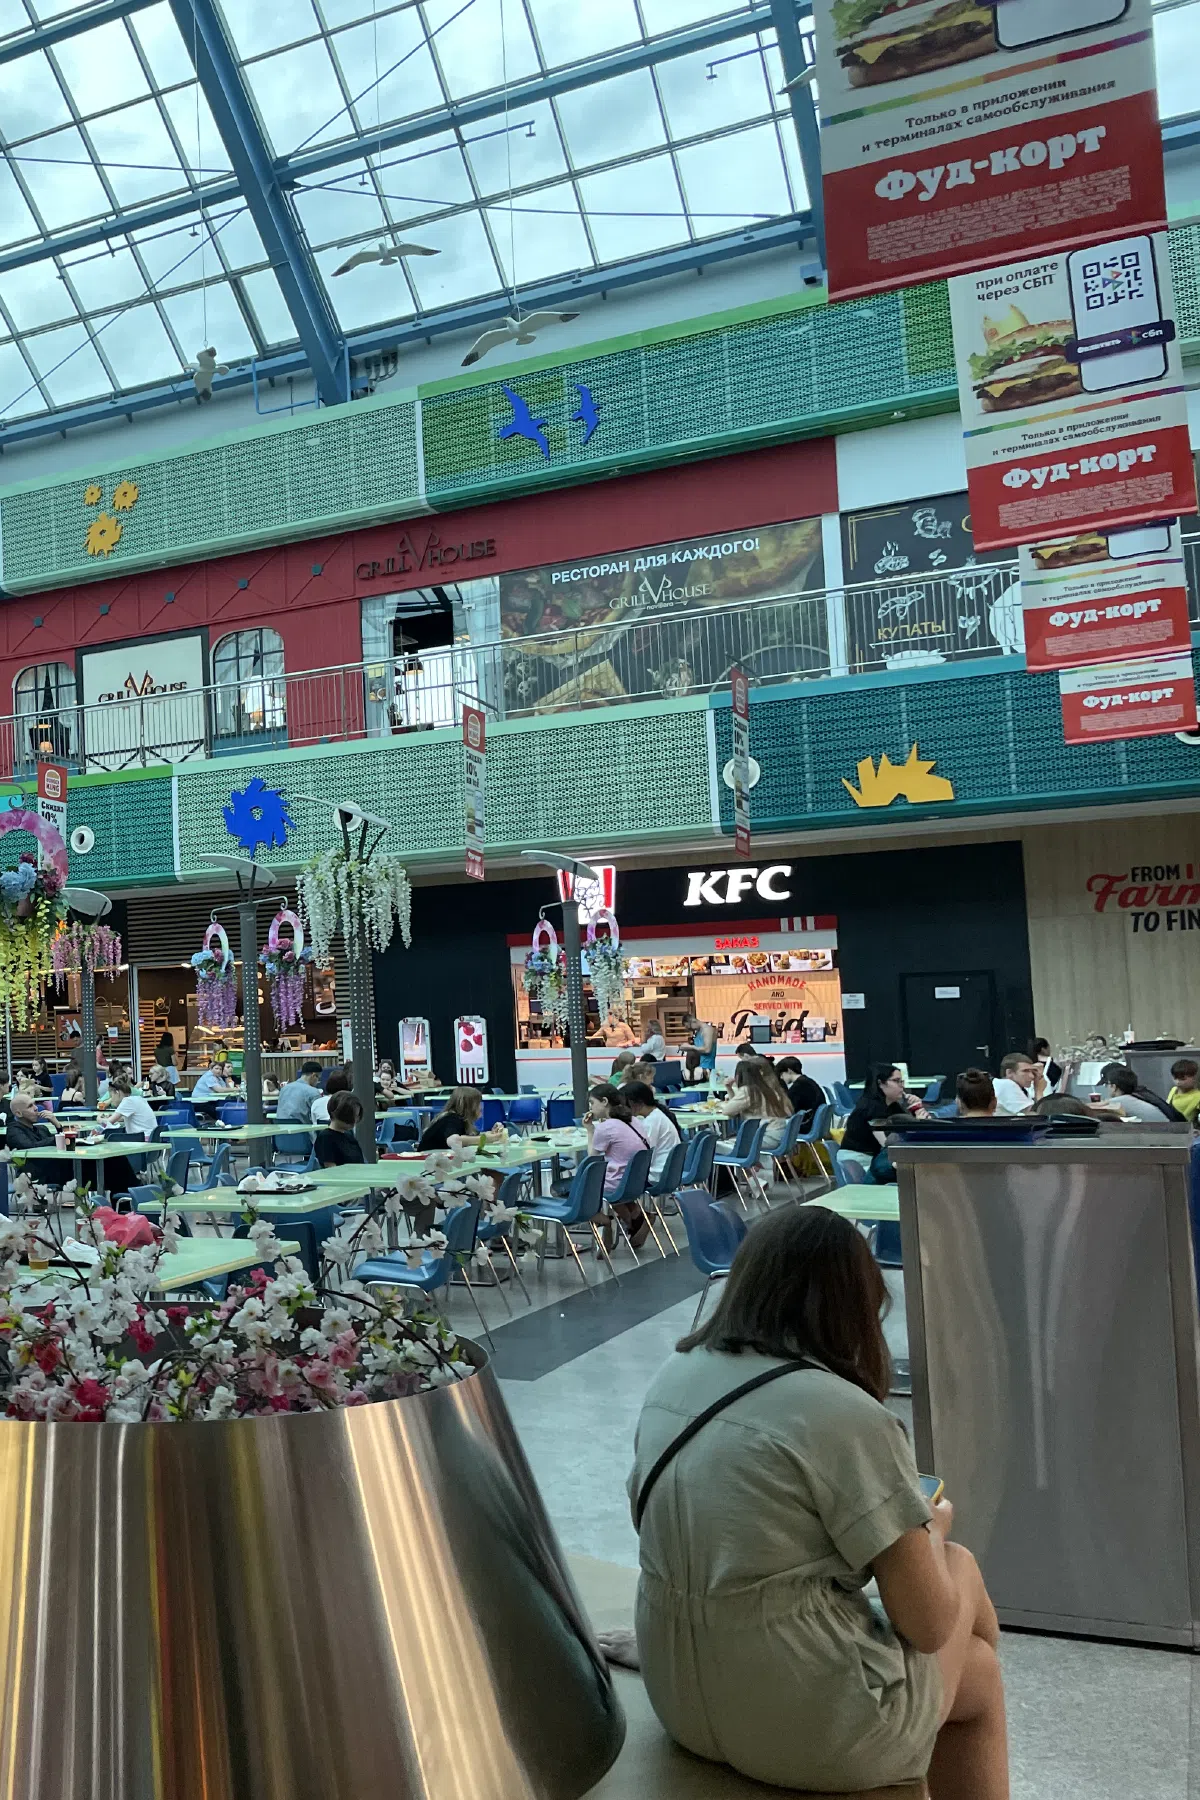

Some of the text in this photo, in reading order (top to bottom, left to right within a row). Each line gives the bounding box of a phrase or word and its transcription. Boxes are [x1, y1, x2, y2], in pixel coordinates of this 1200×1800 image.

[861, 79, 1116, 153] и терминалах самообслуживания
[905, 78, 1067, 128] Только в приложении
[874, 125, 1107, 202] Фуд-корт
[975, 261, 1059, 292] при оплате
[977, 274, 1056, 302] через СБП
[1142, 328, 1164, 339] сбп
[1001, 437, 1060, 454] терминалах
[1062, 415, 1162, 441] самообслуживания
[1021, 429, 1056, 441] Только
[1066, 413, 1129, 432] приложении
[1002, 445, 1157, 490] Фуд-корт
[356, 538, 497, 580] GRILL HOUSE
[551, 538, 760, 585] РЕСТОРАН ДЛЯ КАЖДОГО!
[609, 584, 712, 609] GRILL HOUSE
[1049, 599, 1161, 628] Фуд-корт
[877, 619, 945, 639] КУПАТЫ
[1083, 687, 1174, 710] Фуд-корт
[46, 783, 60, 793] KING
[41, 801, 64, 813] Скидка
[683, 865, 792, 906] KFC
[1131, 864, 1180, 882] FROM
[1131, 911, 1160, 932] TO
[714, 936, 760, 950] ЗАКАЗ
[747, 975, 806, 991] HANDMADE
[754, 1002, 803, 1010] SERVED WITH
